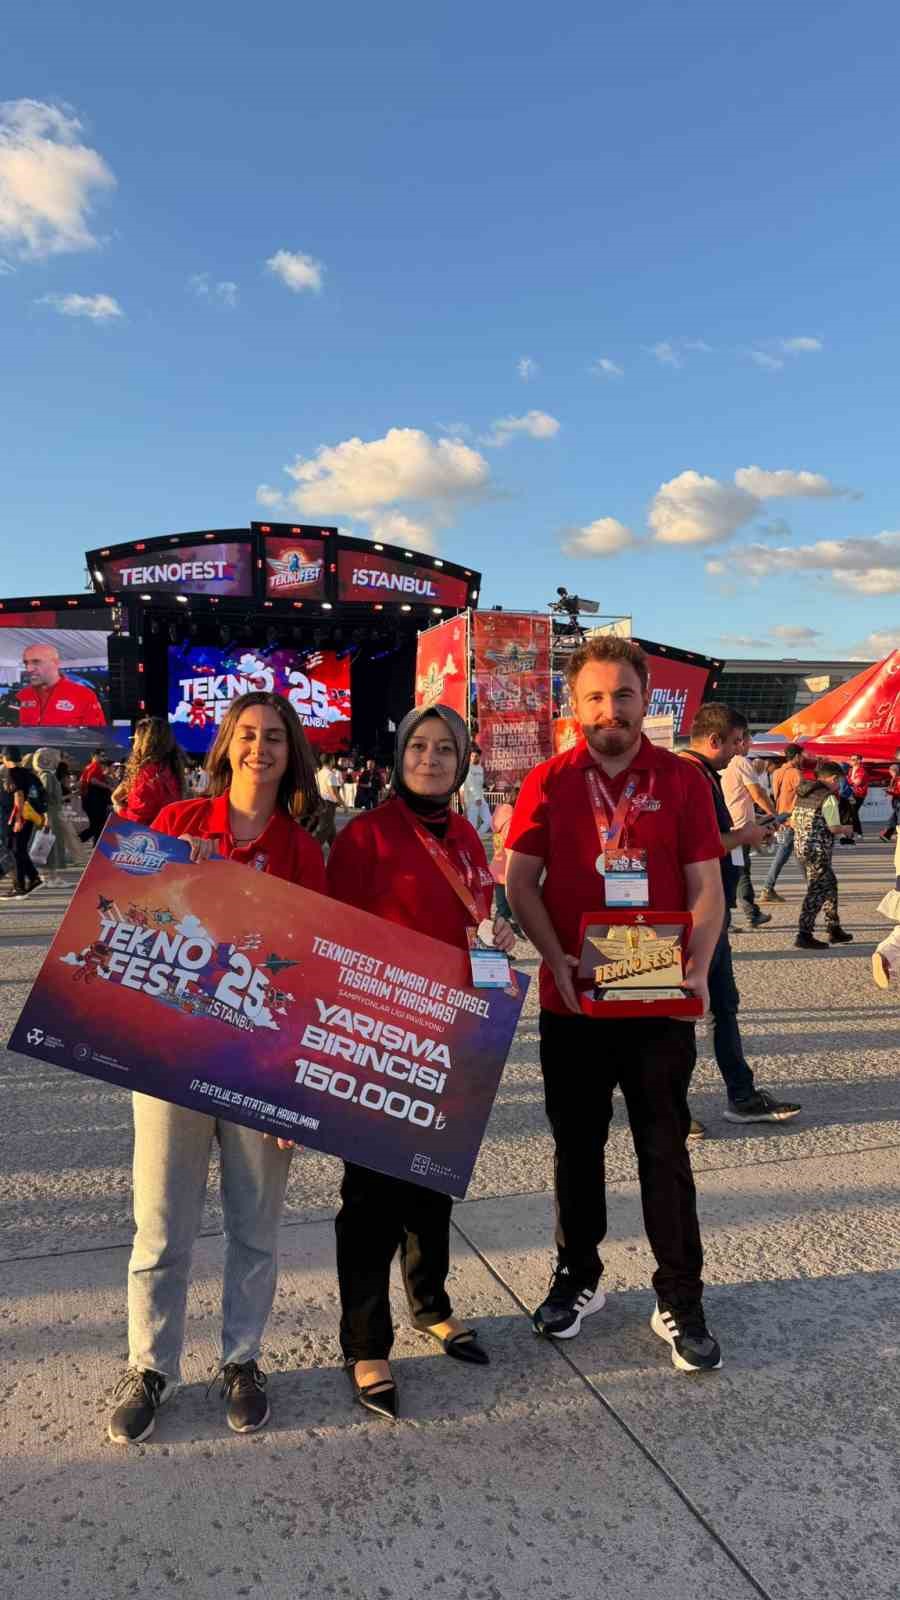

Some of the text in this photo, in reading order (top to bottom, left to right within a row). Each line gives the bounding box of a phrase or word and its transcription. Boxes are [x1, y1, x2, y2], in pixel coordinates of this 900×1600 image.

[120, 561, 227, 586] TEKNOFEST
[269, 567, 321, 587] TEKNOFEST
[179, 670, 274, 701] TEKNO
[111, 851, 168, 868] TEKNOFEST
[99, 920, 213, 969] TEKNO
[108, 953, 200, 998] FEST
[312, 937, 383, 974] TEKNOFEST
[430, 980, 447, 999] VE
[338, 967, 391, 1000] TASARIM
